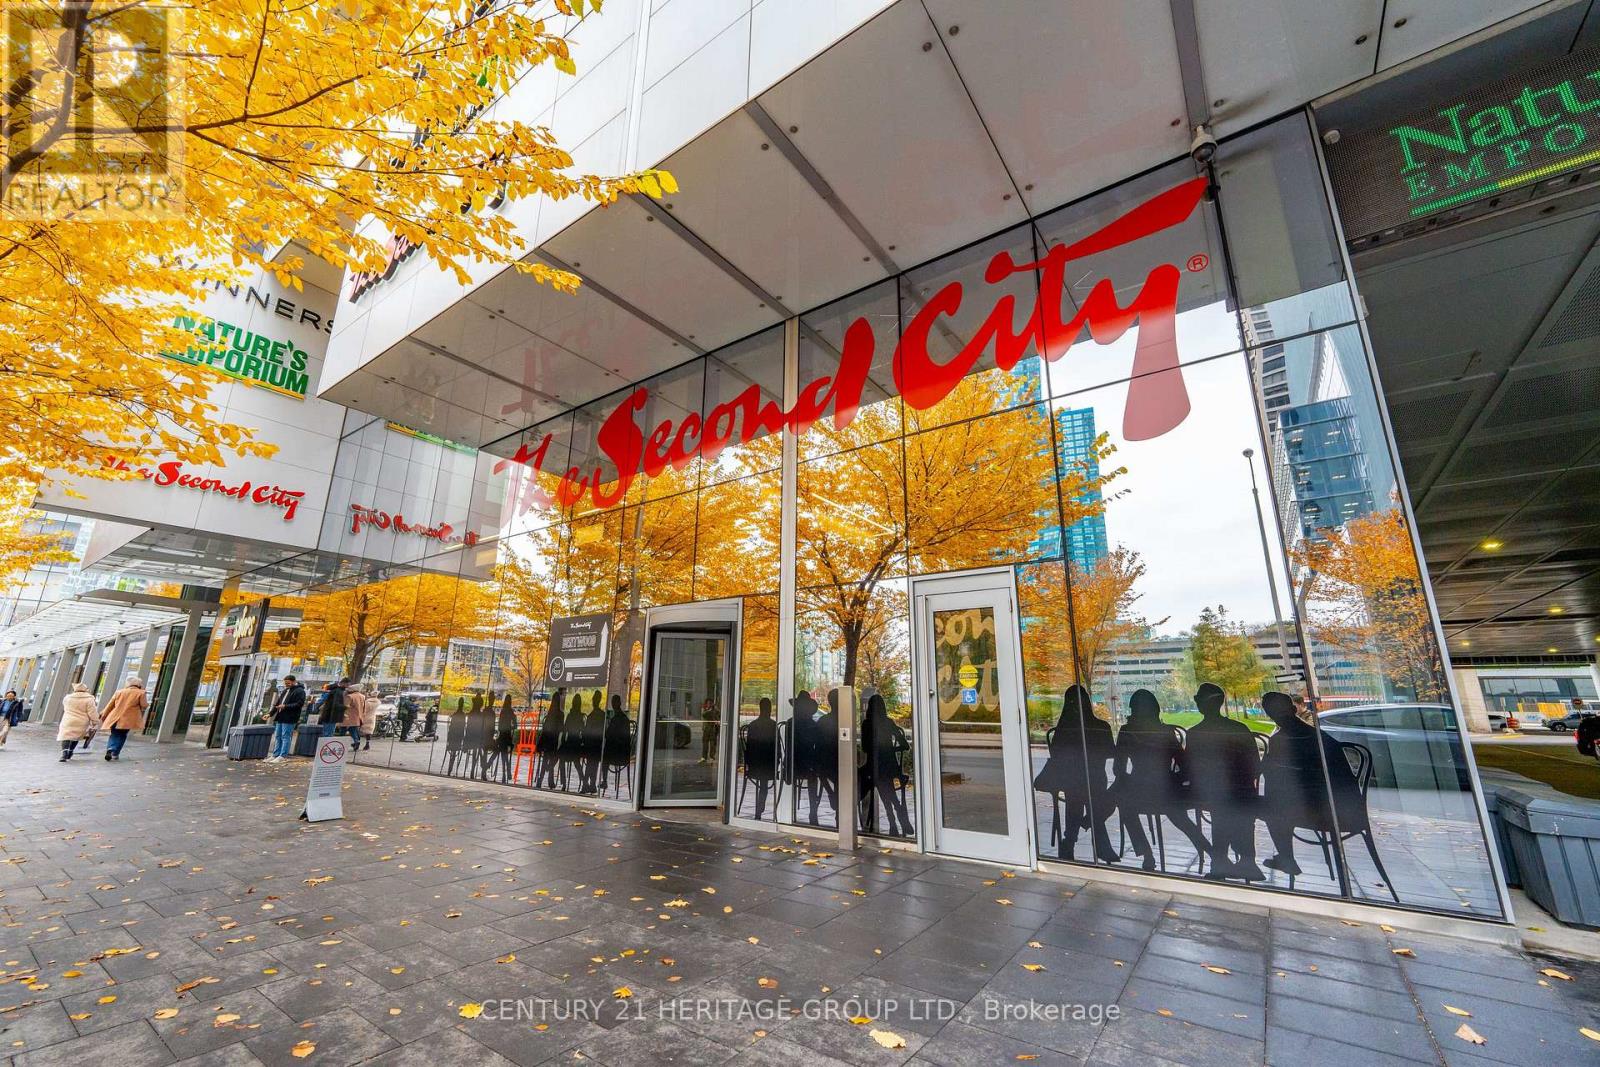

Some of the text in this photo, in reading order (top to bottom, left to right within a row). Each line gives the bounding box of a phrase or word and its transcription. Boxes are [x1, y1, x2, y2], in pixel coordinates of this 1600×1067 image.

[176, 340, 309, 395] MPORIUM
[592, 317, 876, 509] Second
[154, 461, 251, 499] Second
[252, 485, 305, 521] City
